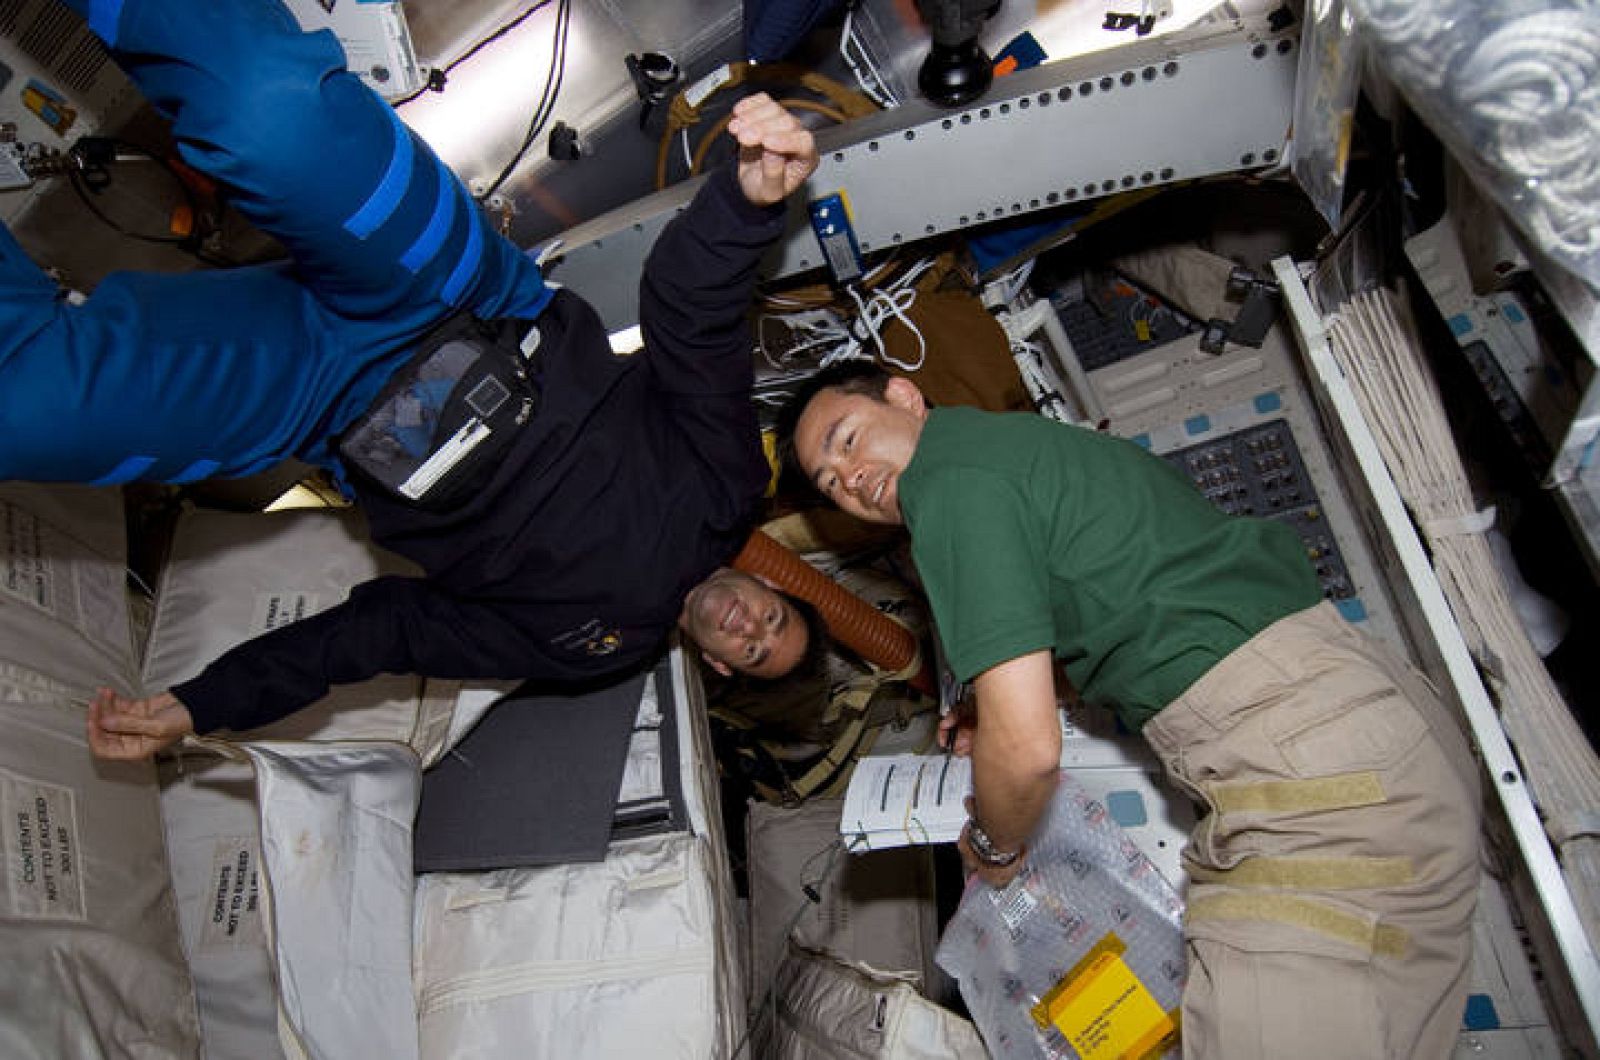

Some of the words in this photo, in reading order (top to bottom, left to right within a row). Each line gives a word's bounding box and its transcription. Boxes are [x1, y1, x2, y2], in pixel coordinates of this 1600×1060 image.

[36, 797, 51, 849] EXCEED
[18, 813, 34, 882] CONTENTS
[41, 850, 53, 868] TO
[44, 873, 57, 901] NOT
[234, 851, 249, 892] EXCEED
[213, 866, 231, 922] CONTENTS
[230, 894, 242, 910] TO
[227, 912, 239, 936] NOT
